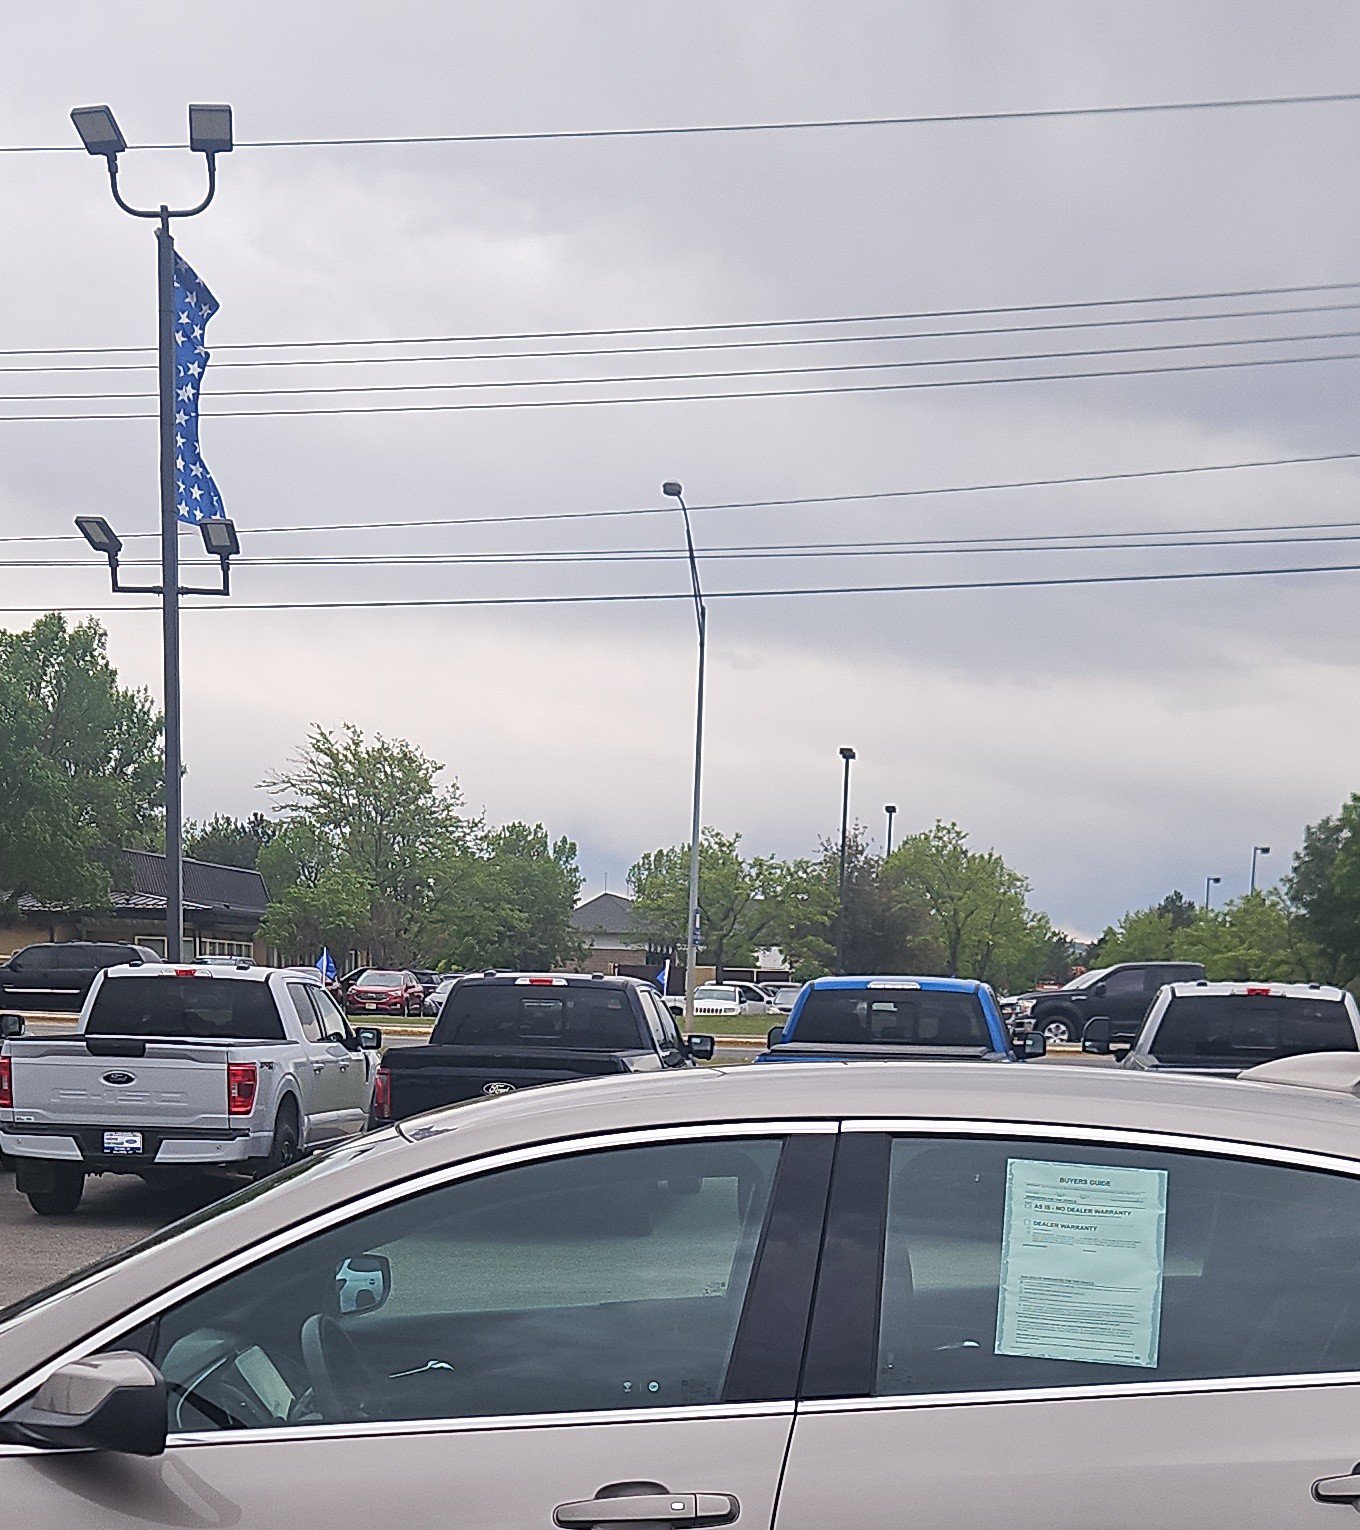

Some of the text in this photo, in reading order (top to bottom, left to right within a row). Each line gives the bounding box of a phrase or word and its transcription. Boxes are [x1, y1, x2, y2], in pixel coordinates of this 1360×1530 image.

[1059, 1177, 1111, 1187] BUYERS GUIDE
[1066, 1206, 1093, 1215] DEALER
[1093, 1208, 1132, 1217] WARRANTY
[1033, 1220, 1098, 1232] DEALER WARRANTY
